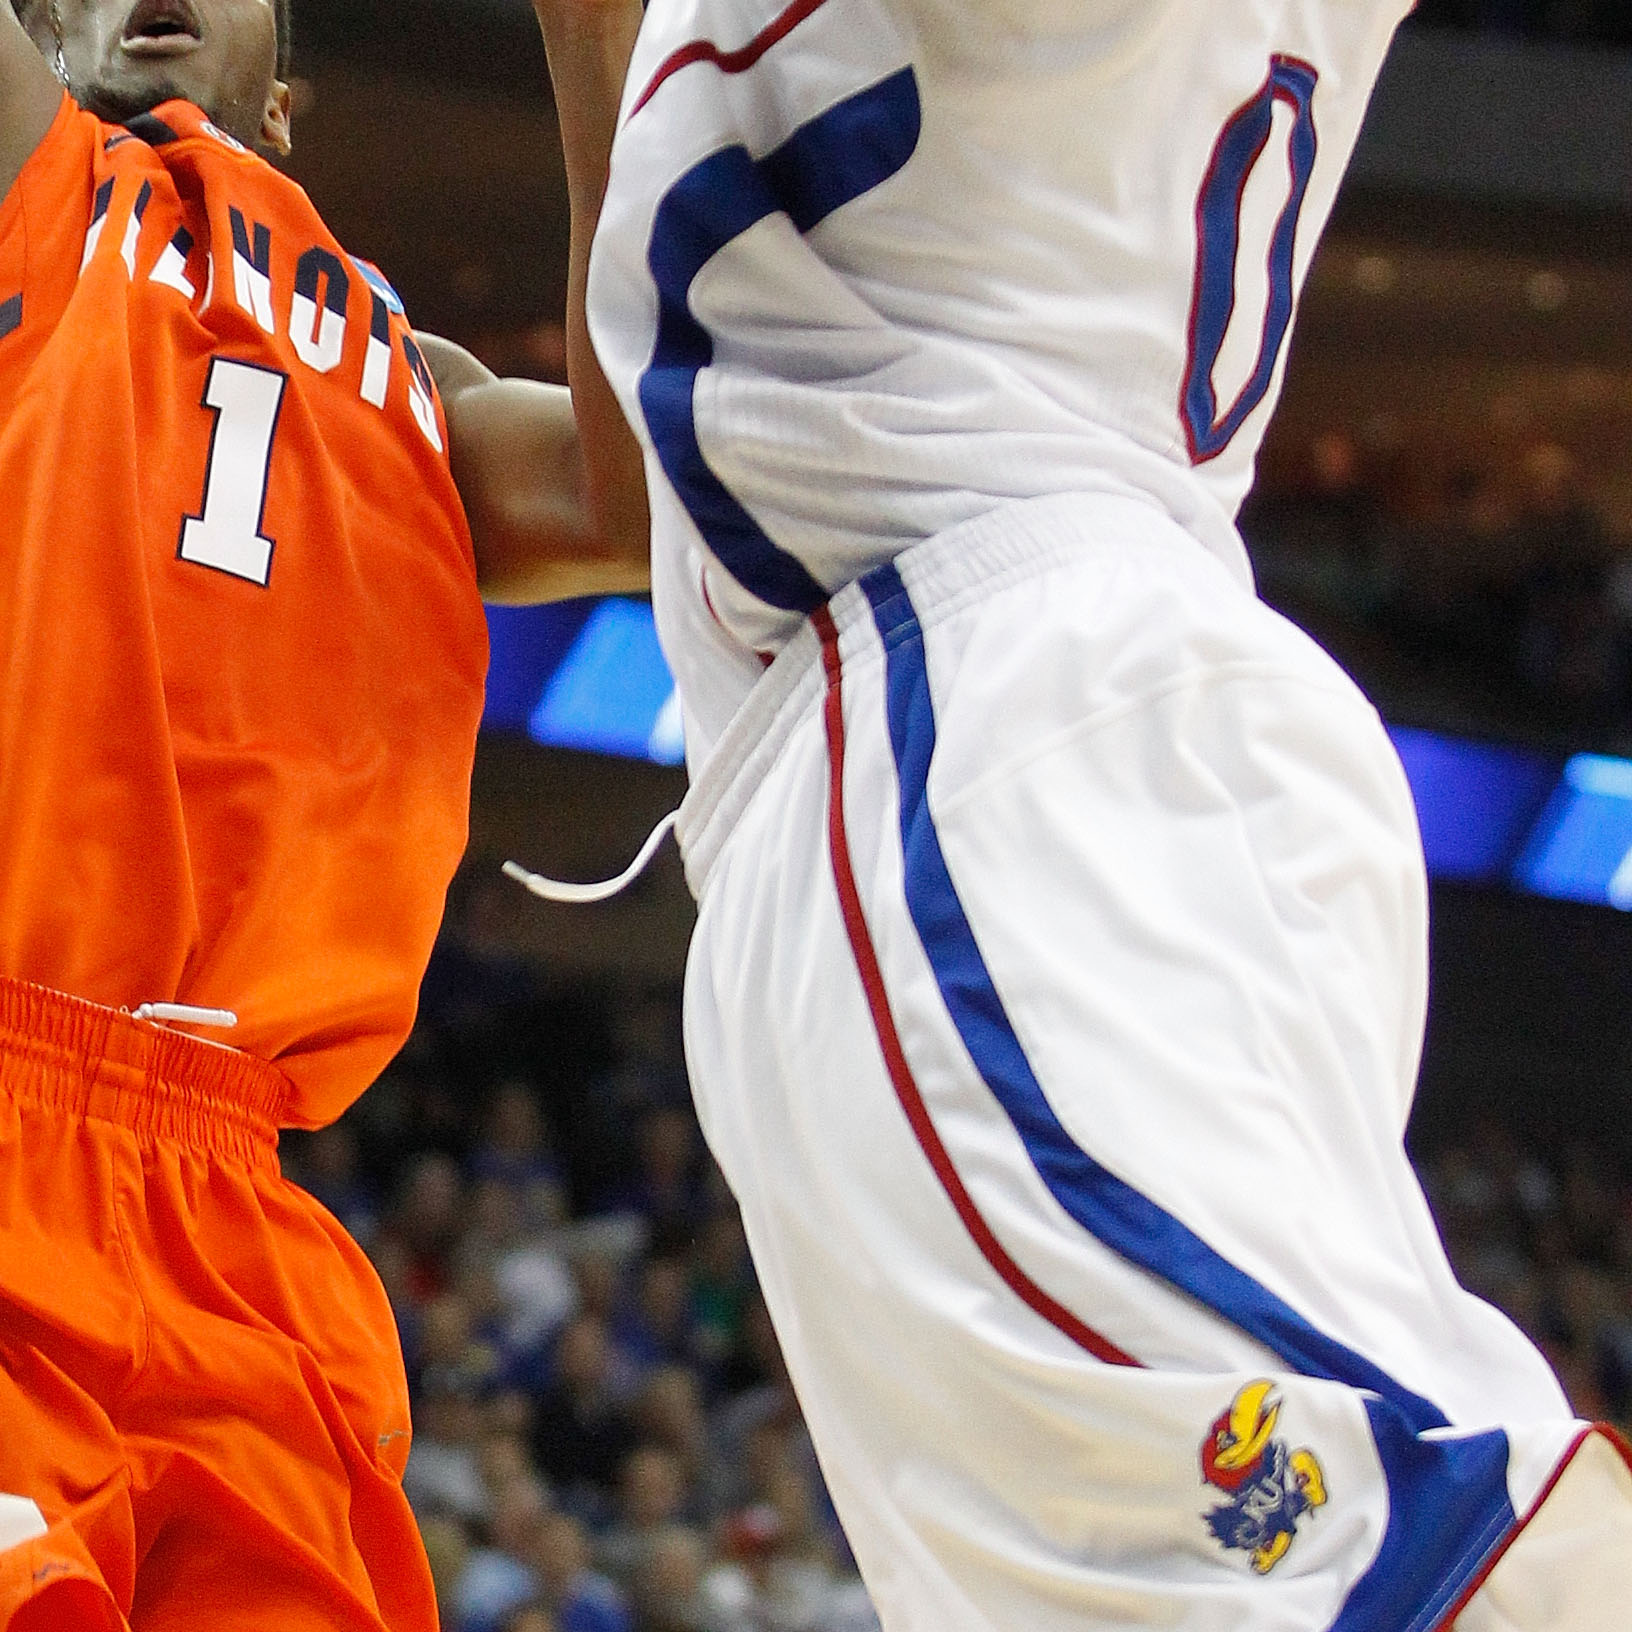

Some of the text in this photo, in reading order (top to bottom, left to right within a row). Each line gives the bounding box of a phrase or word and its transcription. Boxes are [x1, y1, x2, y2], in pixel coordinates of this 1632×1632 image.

[78, 174, 444, 455] ILNOIS
[1180, 52, 1319, 465] 0
[176, 354, 289, 589] 1
